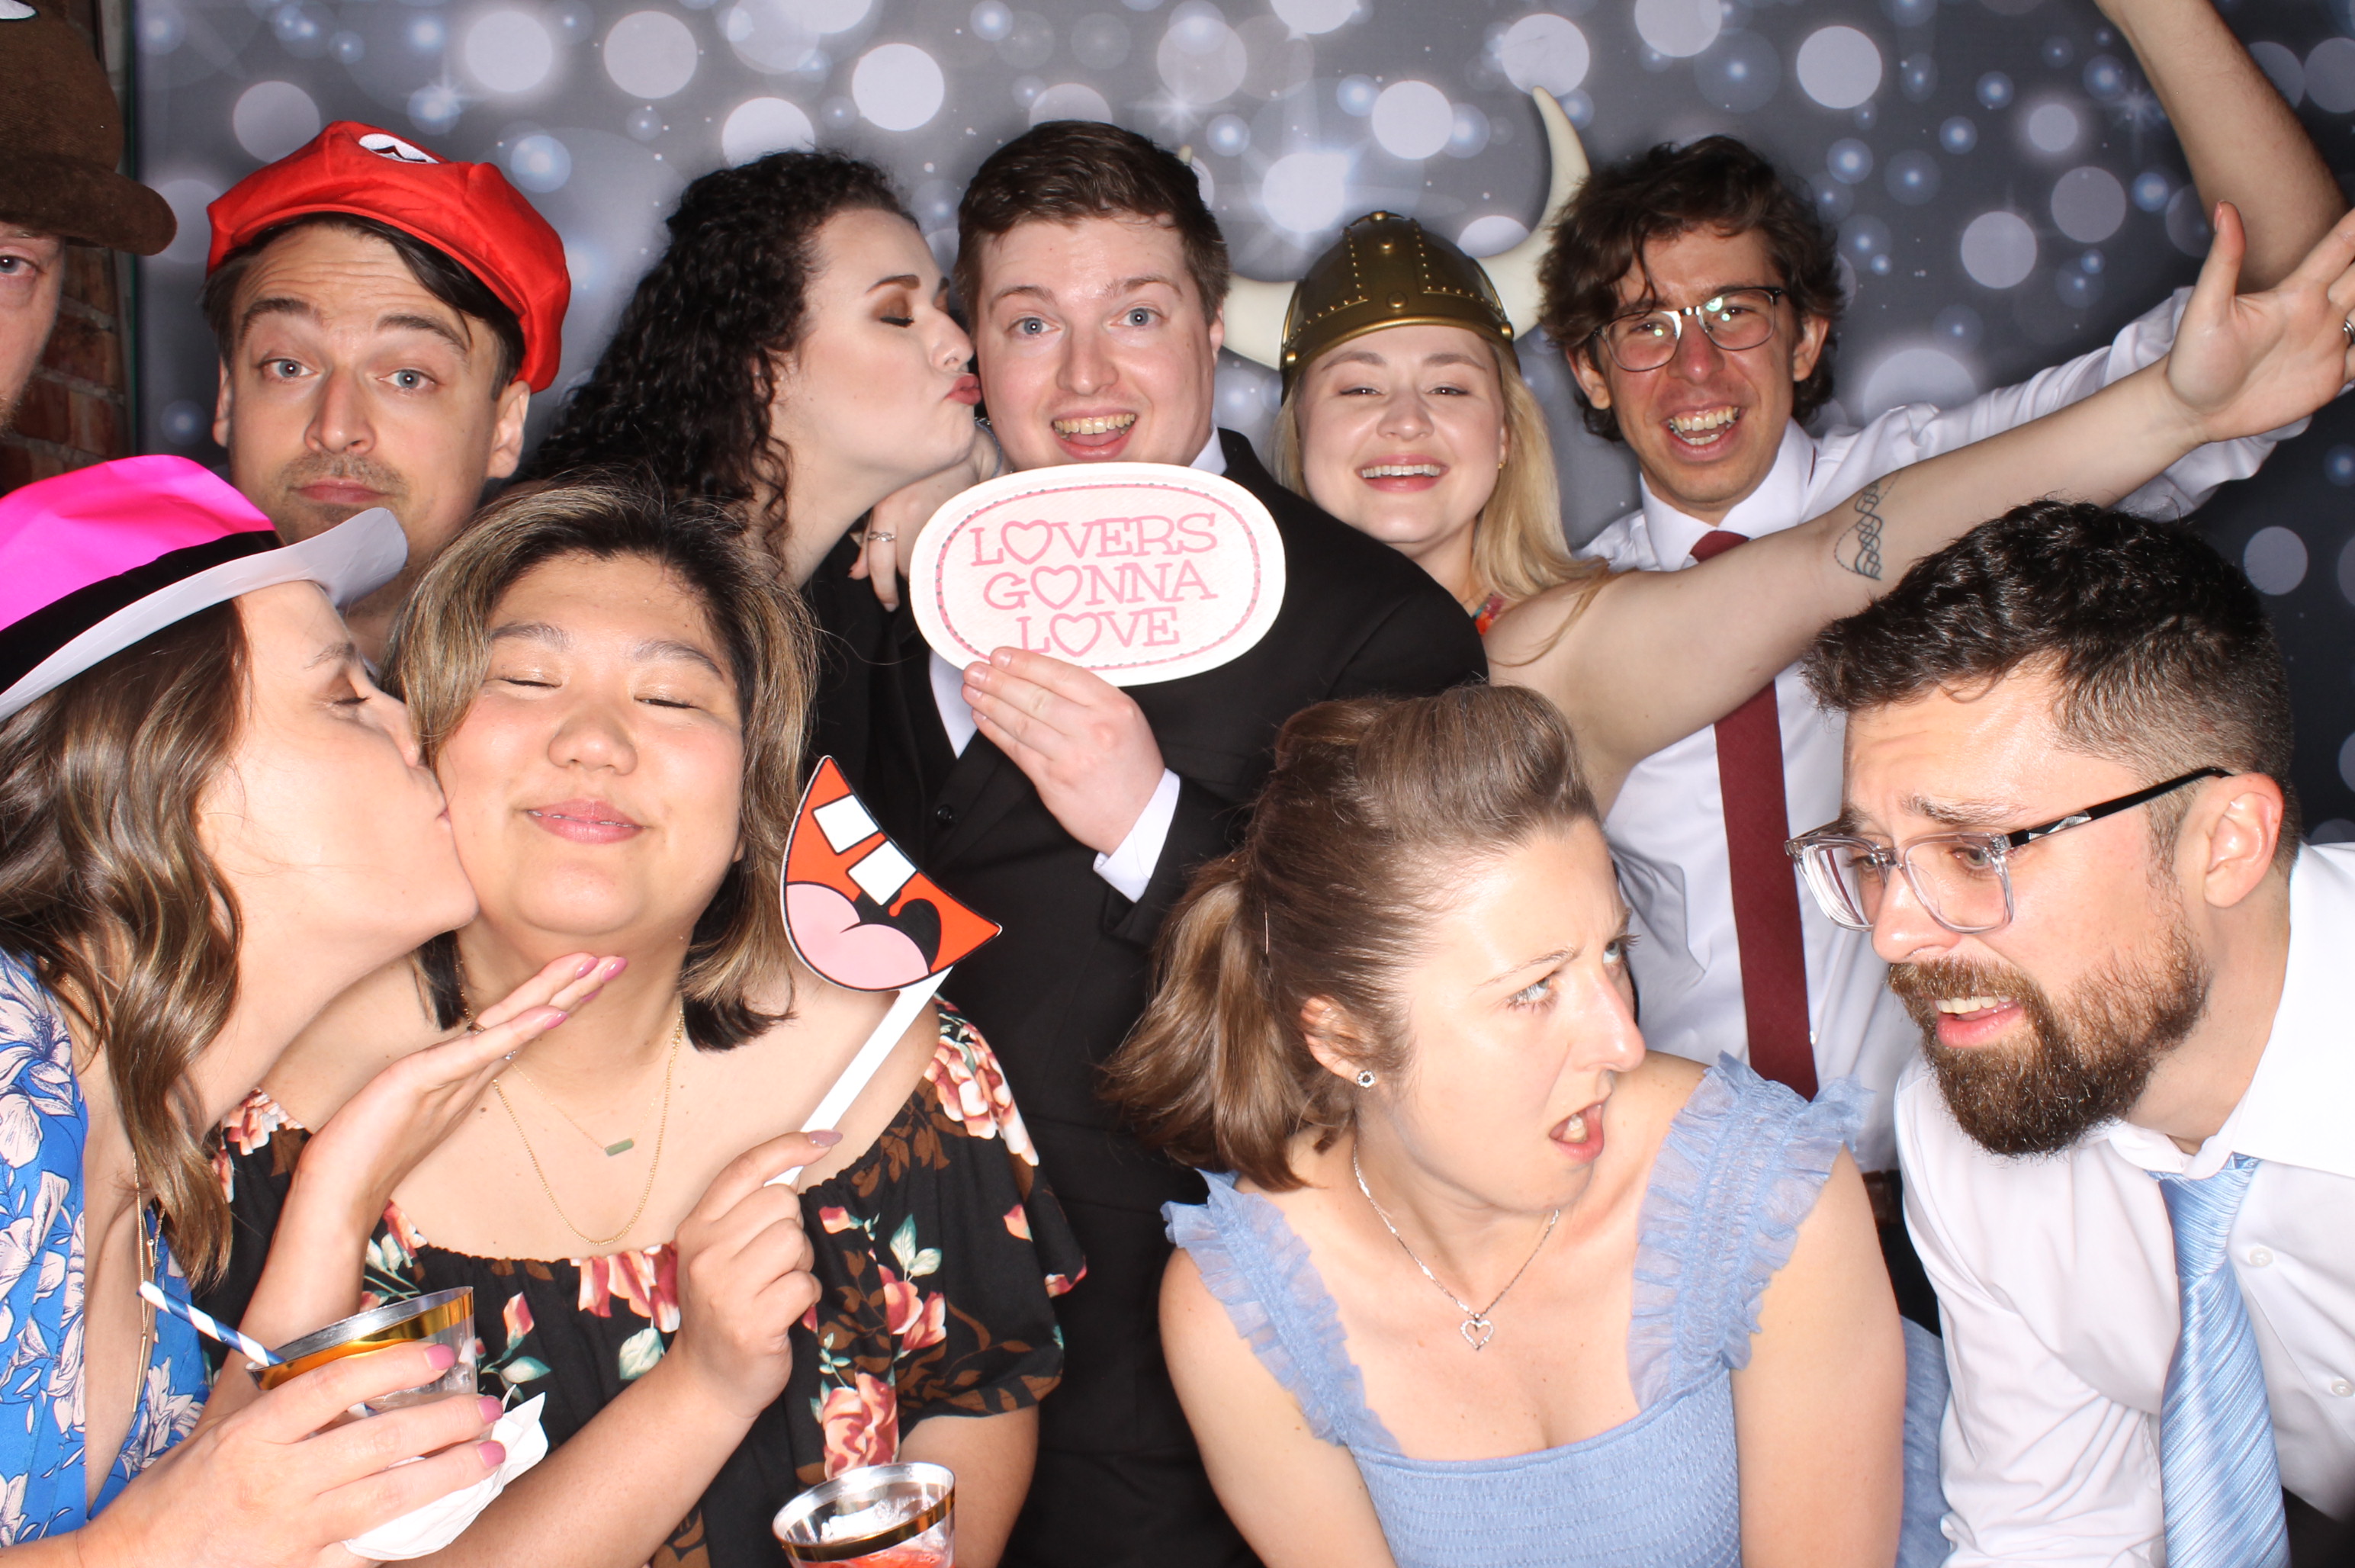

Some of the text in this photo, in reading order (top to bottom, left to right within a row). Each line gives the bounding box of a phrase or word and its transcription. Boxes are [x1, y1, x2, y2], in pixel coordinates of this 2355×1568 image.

[969, 512, 1218, 566] LOVERS
[983, 560, 1219, 610] GONNA
[1016, 607, 1180, 657] LOVE
